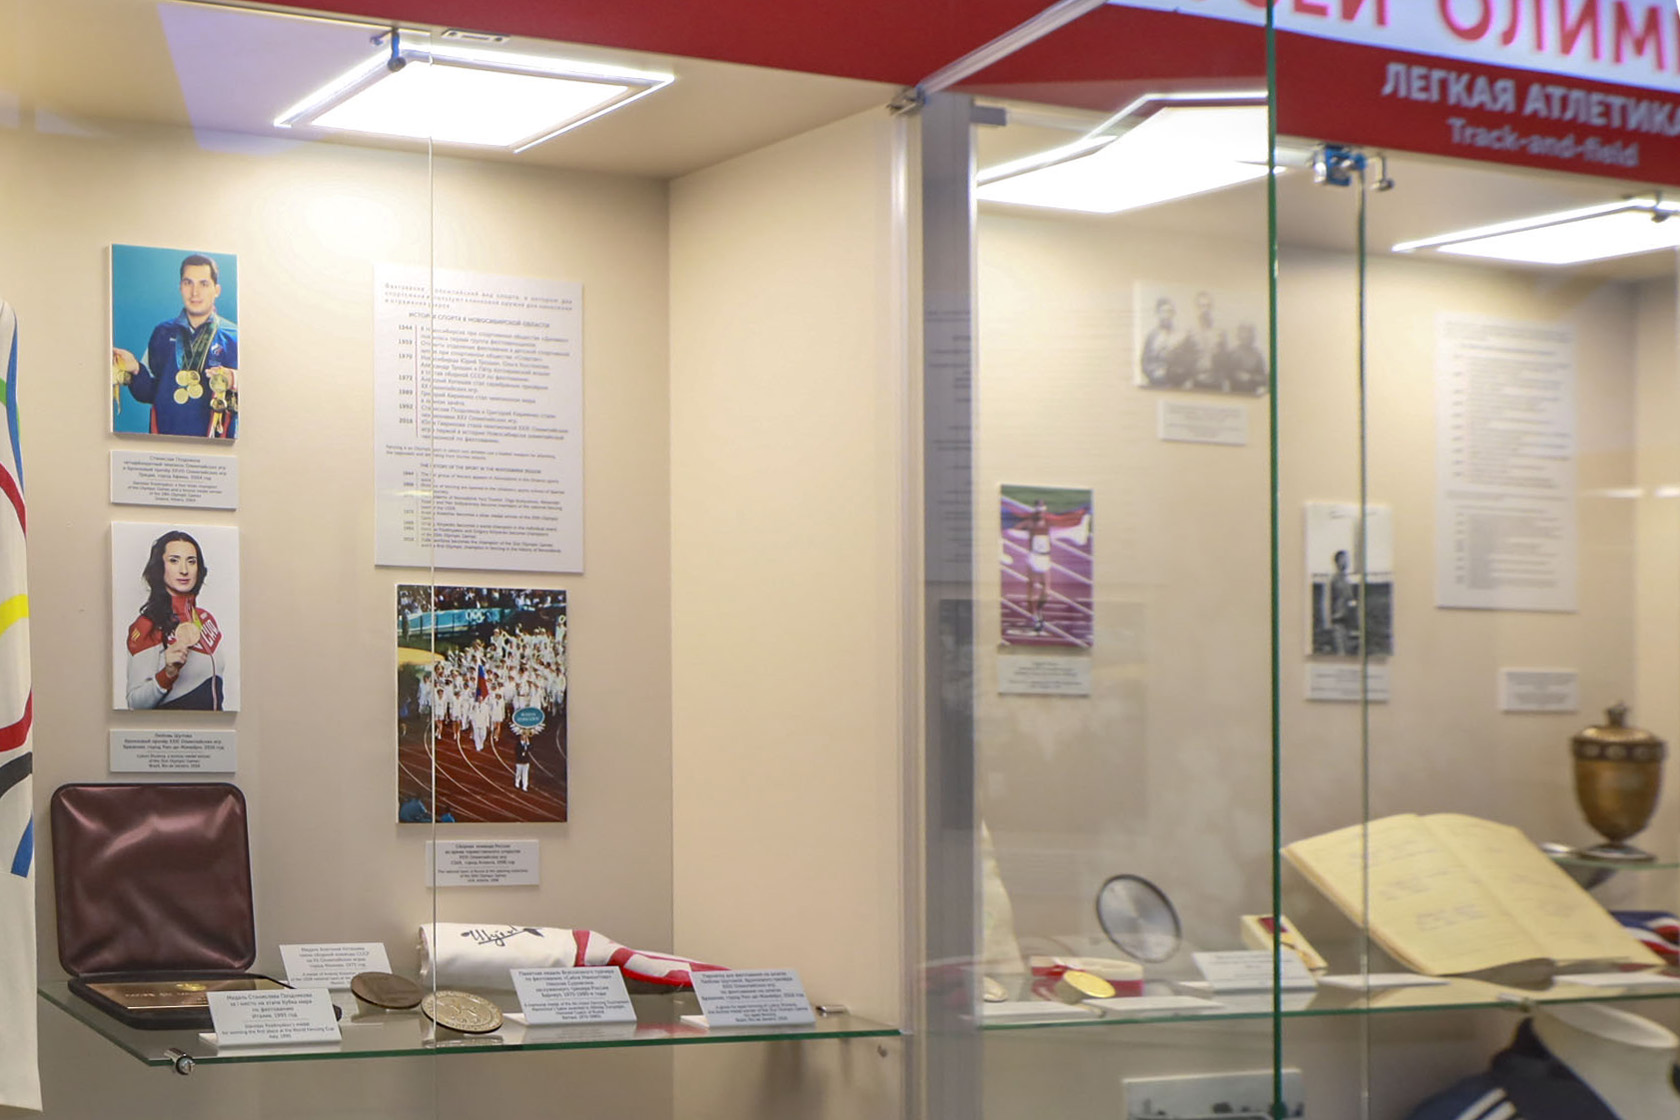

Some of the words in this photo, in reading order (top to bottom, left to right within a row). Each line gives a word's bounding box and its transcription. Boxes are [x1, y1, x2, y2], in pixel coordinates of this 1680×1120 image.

[1438, 0, 1680, 72] ОЛИМ
[1381, 62, 1516, 113] ЛЕГКАЯ
[1446, 117, 1639, 168] Track-and-field
